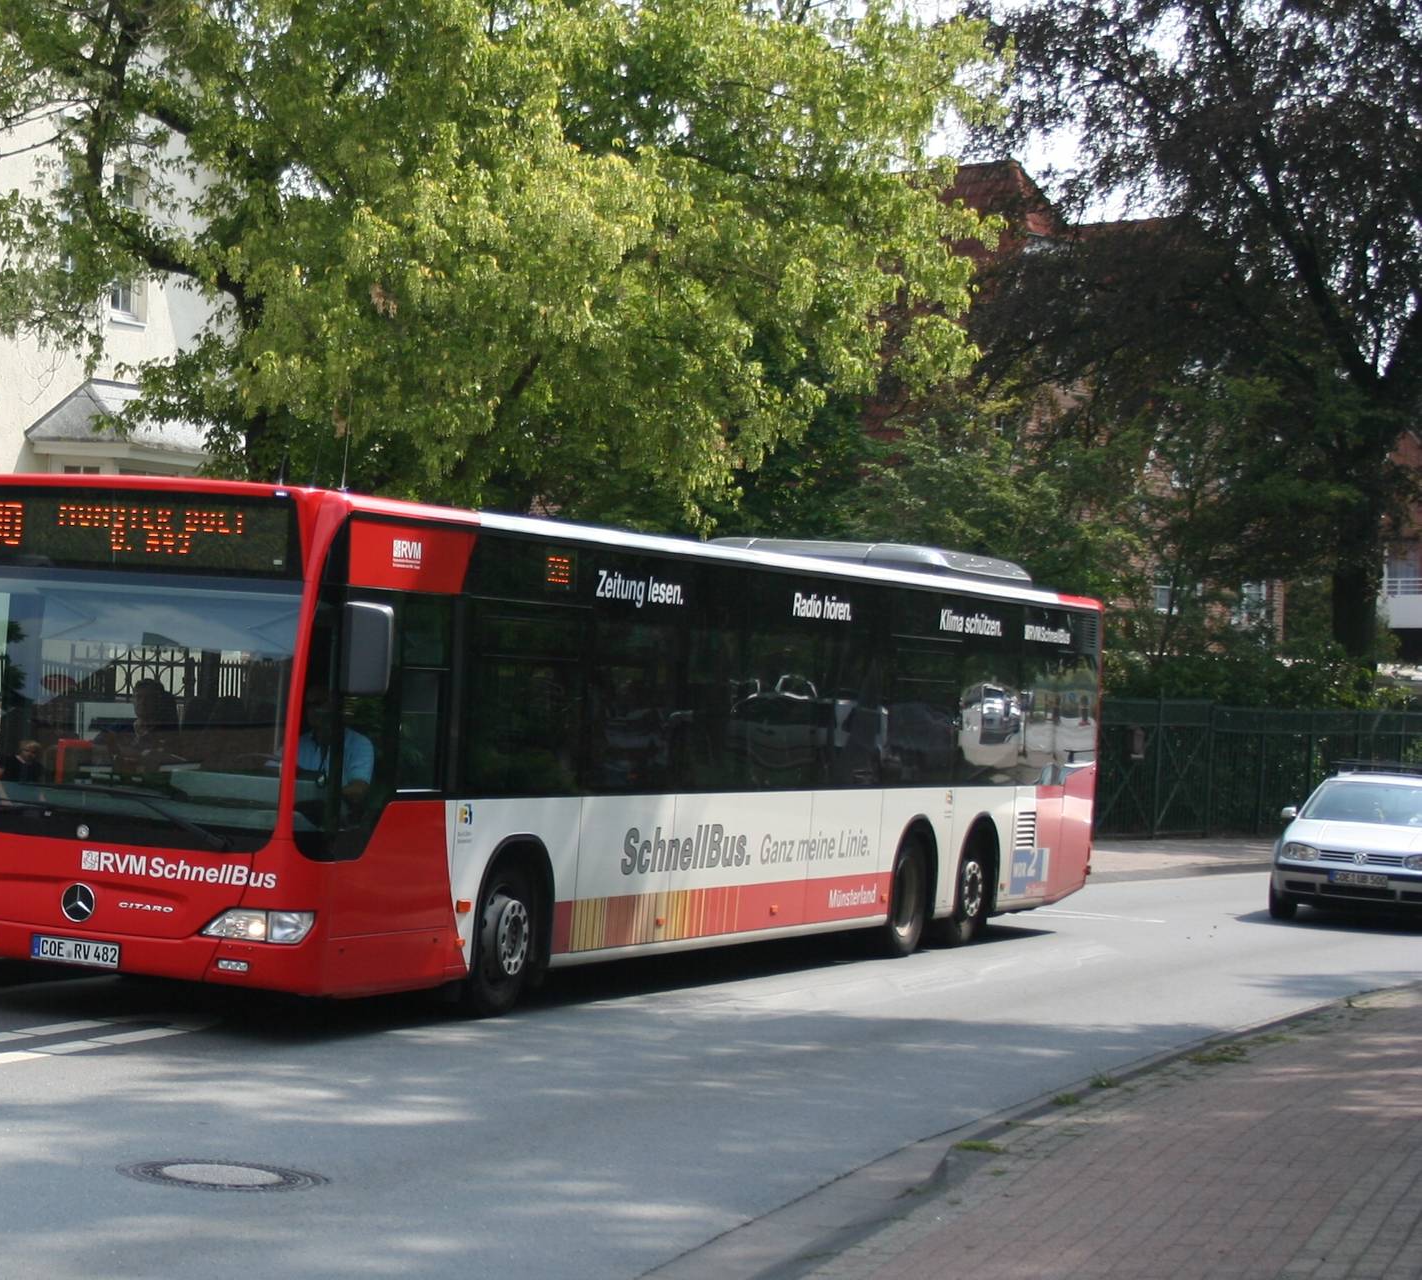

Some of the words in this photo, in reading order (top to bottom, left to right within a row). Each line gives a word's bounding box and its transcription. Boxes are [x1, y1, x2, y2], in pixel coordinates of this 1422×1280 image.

[401, 540, 422, 560] RVM
[596, 569, 645, 608] Zeitung
[647, 575, 684, 605] lesen.
[793, 592, 821, 619] Radio
[823, 596, 852, 621] hören.
[939, 608, 964, 633] Klima
[965, 613, 1002, 637] schützen.
[621, 824, 751, 876] SchnellBus.
[759, 833, 795, 866] Ganz
[796, 832, 835, 862] meine
[838, 828, 871, 858] Linie.
[99, 852, 146, 876] RVM
[149, 857, 277, 889] SchnellBus
[118, 902, 174, 913] CITARO
[828, 883, 877, 908] Münsterland
[41, 939, 66, 957] COE
[74, 943, 91, 960] RV
[93, 946, 118, 964] 482
